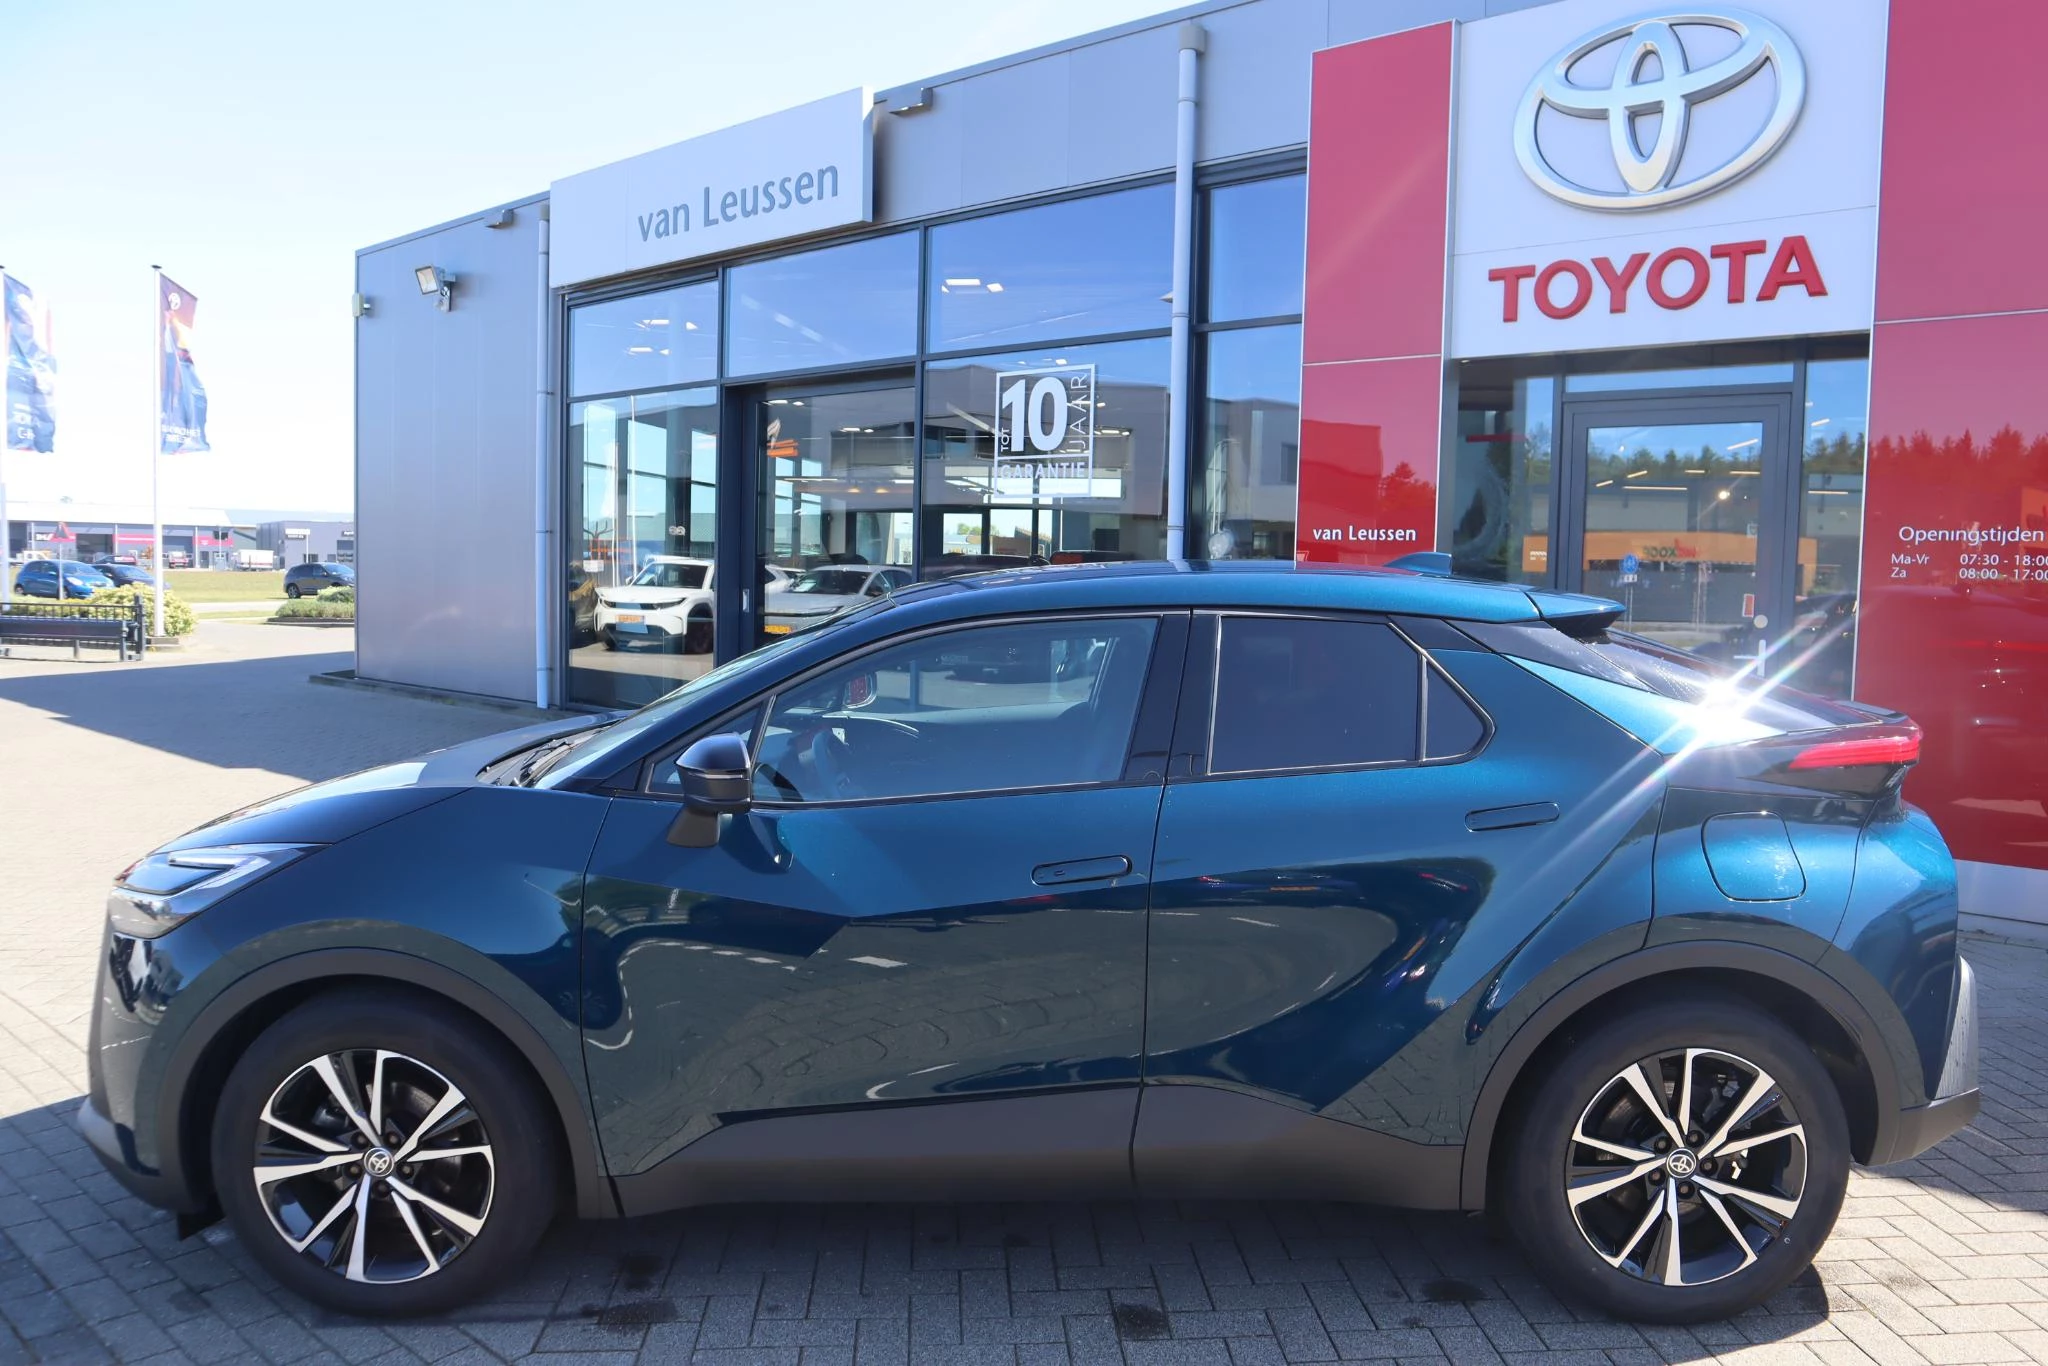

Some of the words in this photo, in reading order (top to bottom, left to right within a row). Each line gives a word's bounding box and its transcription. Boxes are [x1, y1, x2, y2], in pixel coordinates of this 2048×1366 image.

[637, 203, 690, 242] van
[703, 165, 839, 228] Leussen
[1488, 235, 1829, 323] TOYOTA
[1002, 376, 1068, 452] 10
[1069, 374, 1088, 449] JAAR
[1001, 428, 1010, 452] TOT
[1002, 462, 1085, 479] GARANTIE
[1312, 528, 1342, 541] van
[1348, 525, 1417, 541] Leussen
[1899, 526, 2044, 546] Openingstijden
[1891, 553, 1930, 565] Ma-Vr
[1960, 554, 1999, 566] 07:30
[1890, 567, 1907, 578] Za
[1959, 568, 1998, 579] 08:00
